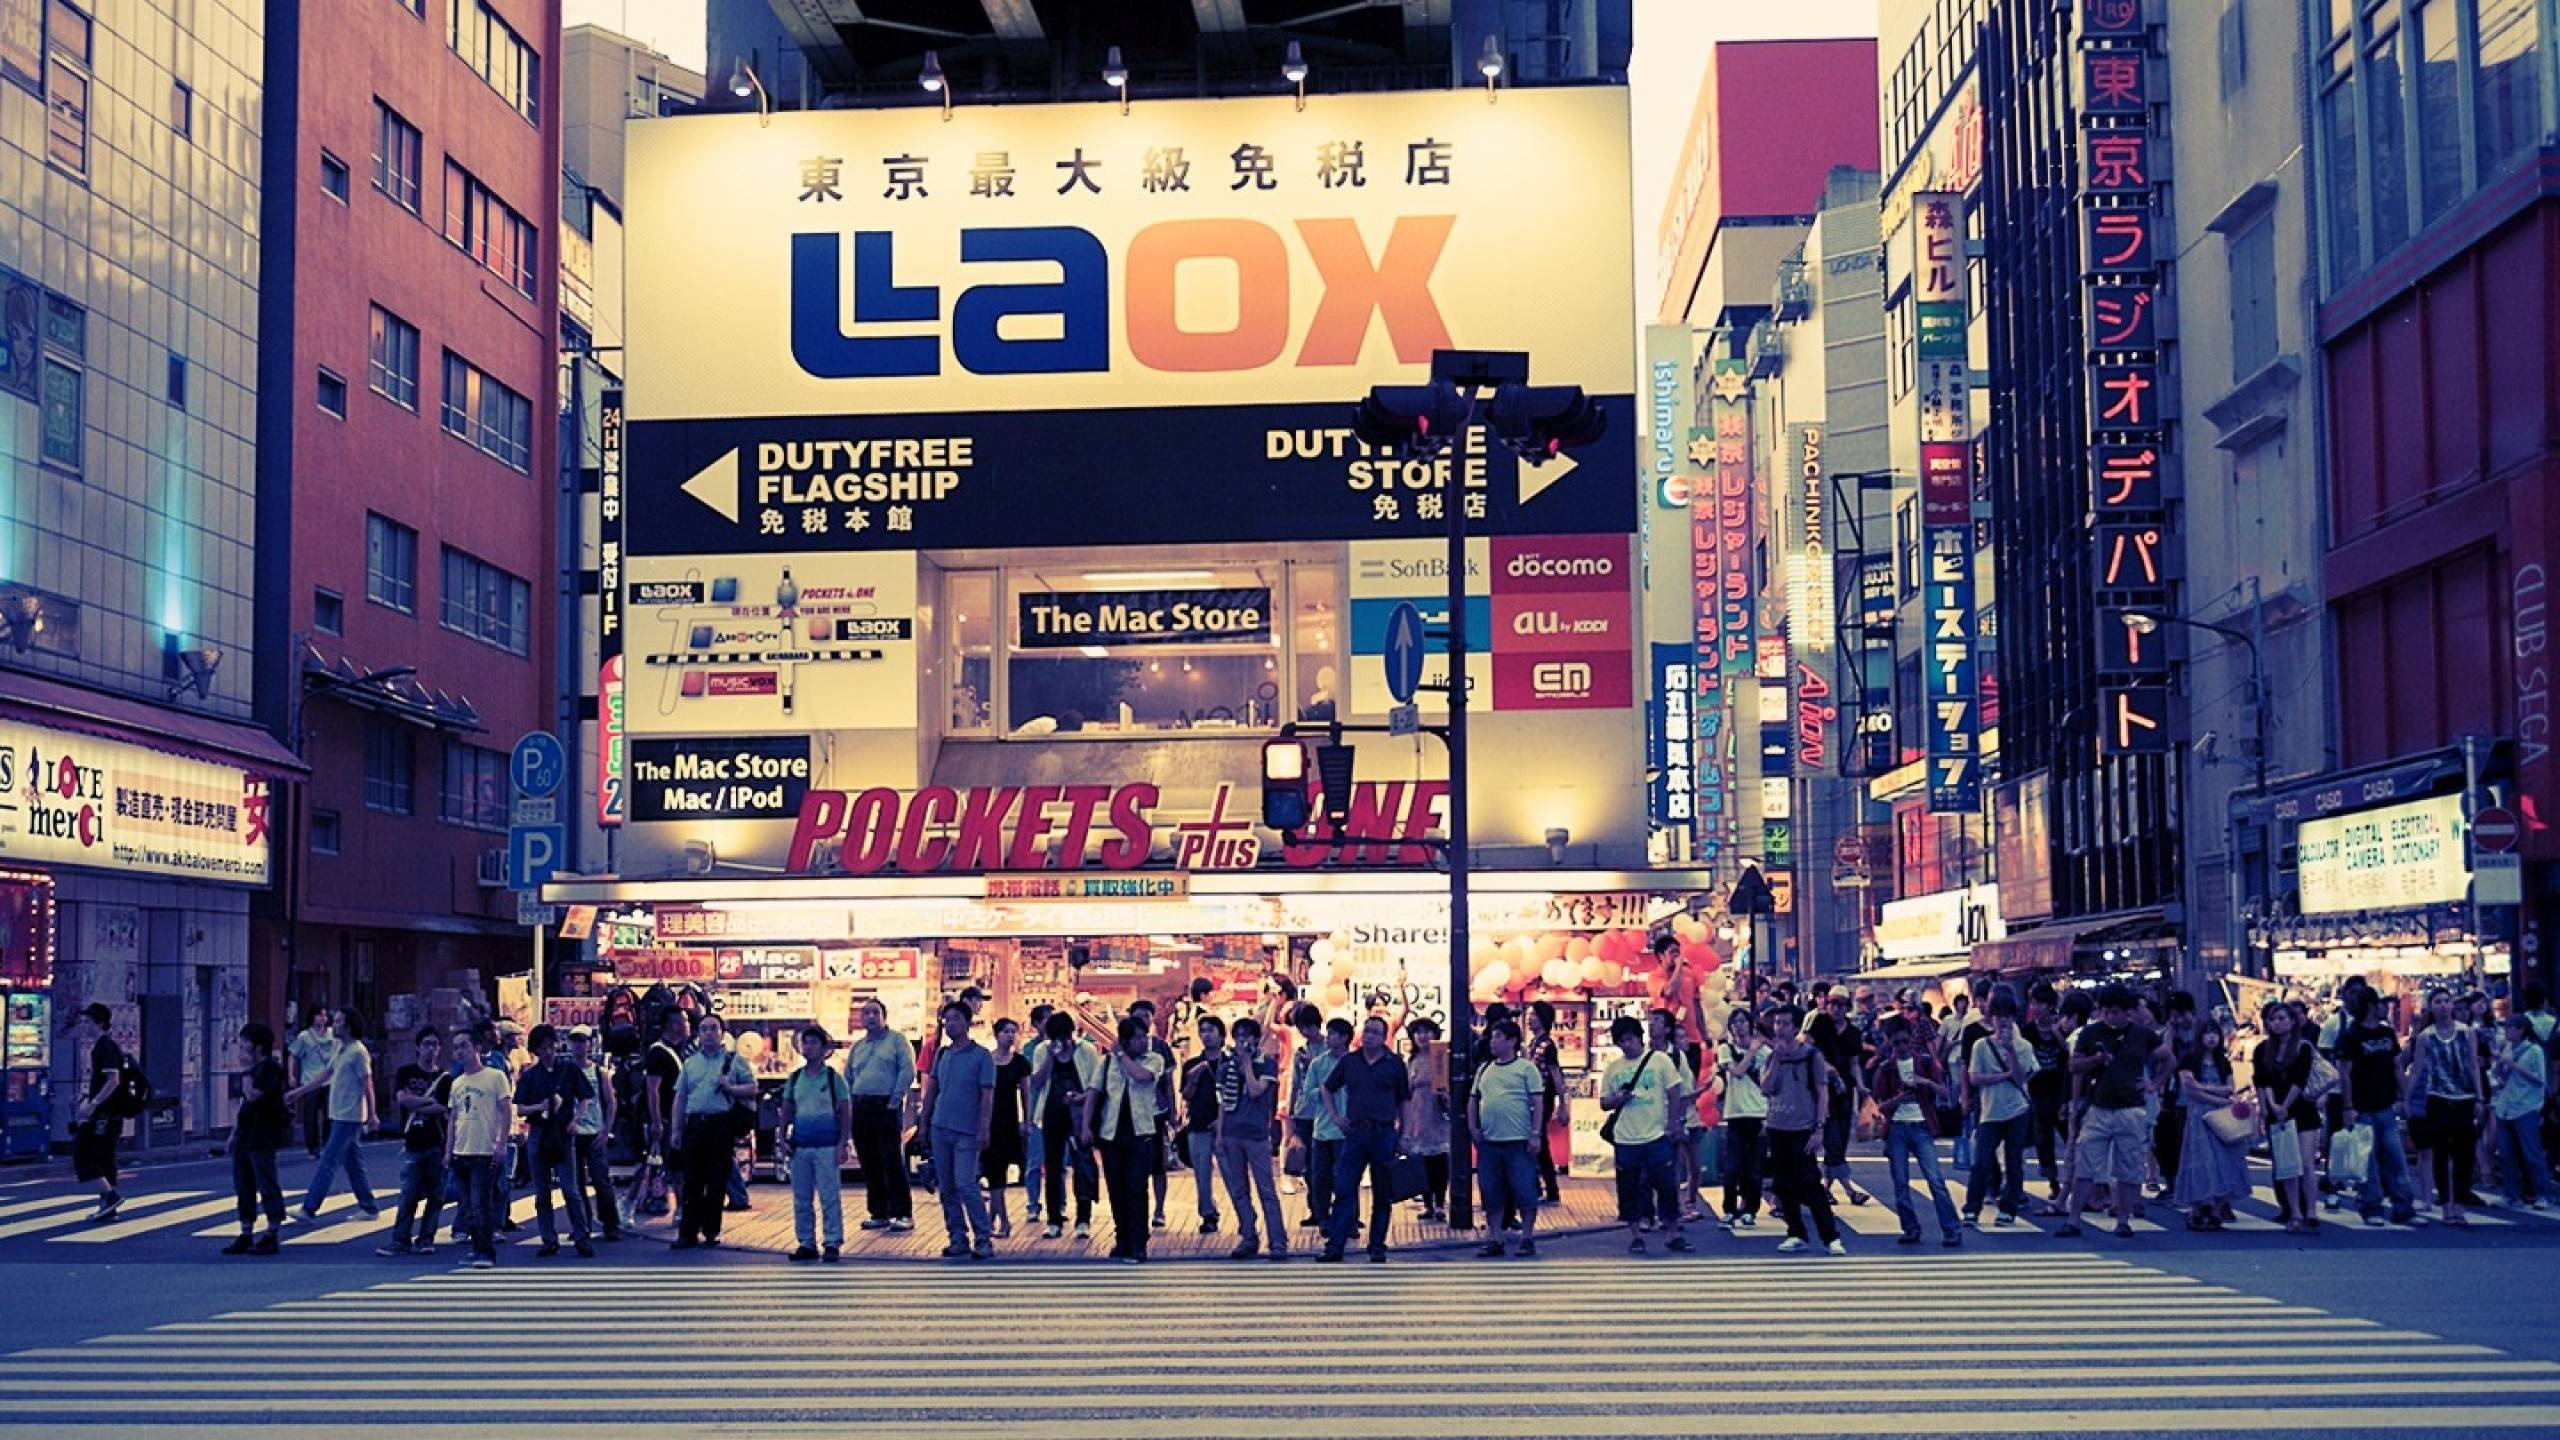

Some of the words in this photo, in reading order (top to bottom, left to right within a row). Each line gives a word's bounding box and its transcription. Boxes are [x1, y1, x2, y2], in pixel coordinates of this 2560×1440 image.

[798, 136, 1453, 203] 東京最大級免税店
[1655, 360, 1680, 474] ishimaru
[2089, 55, 2159, 747] 東京ラジオデパート
[758, 438, 974, 471] DUTYFREE
[758, 471, 959, 504] FLAGSHIP
[1803, 428, 1824, 560] PACHINKO
[760, 505, 915, 535] 免税本館
[1373, 494, 1487, 521] 免税店
[1391, 557, 1478, 578] SoftBk
[1507, 554, 1613, 576] docomo
[801, 588, 846, 600] POCKETS
[2514, 562, 2546, 657] CLUB
[1031, 605, 1092, 635] The
[1098, 604, 1165, 633] Mac
[1171, 601, 1260, 631] Store
[1513, 611, 1559, 634] au
[2517, 667, 2549, 766] SEGA
[46, 755, 104, 800] LOVE
[522, 748, 543, 787] P
[635, 760, 671, 780] The
[675, 753, 730, 780] Mac
[735, 752, 809, 779] Store
[664, 785, 712, 811] Mac
[730, 784, 784, 809] iPod
[2316, 789, 2344, 811] CASIO
[2363, 778, 2395, 801] CASIO
[787, 784, 1161, 873] POCKETS
[523, 832, 552, 883] P
[1353, 923, 1448, 944] Share!
